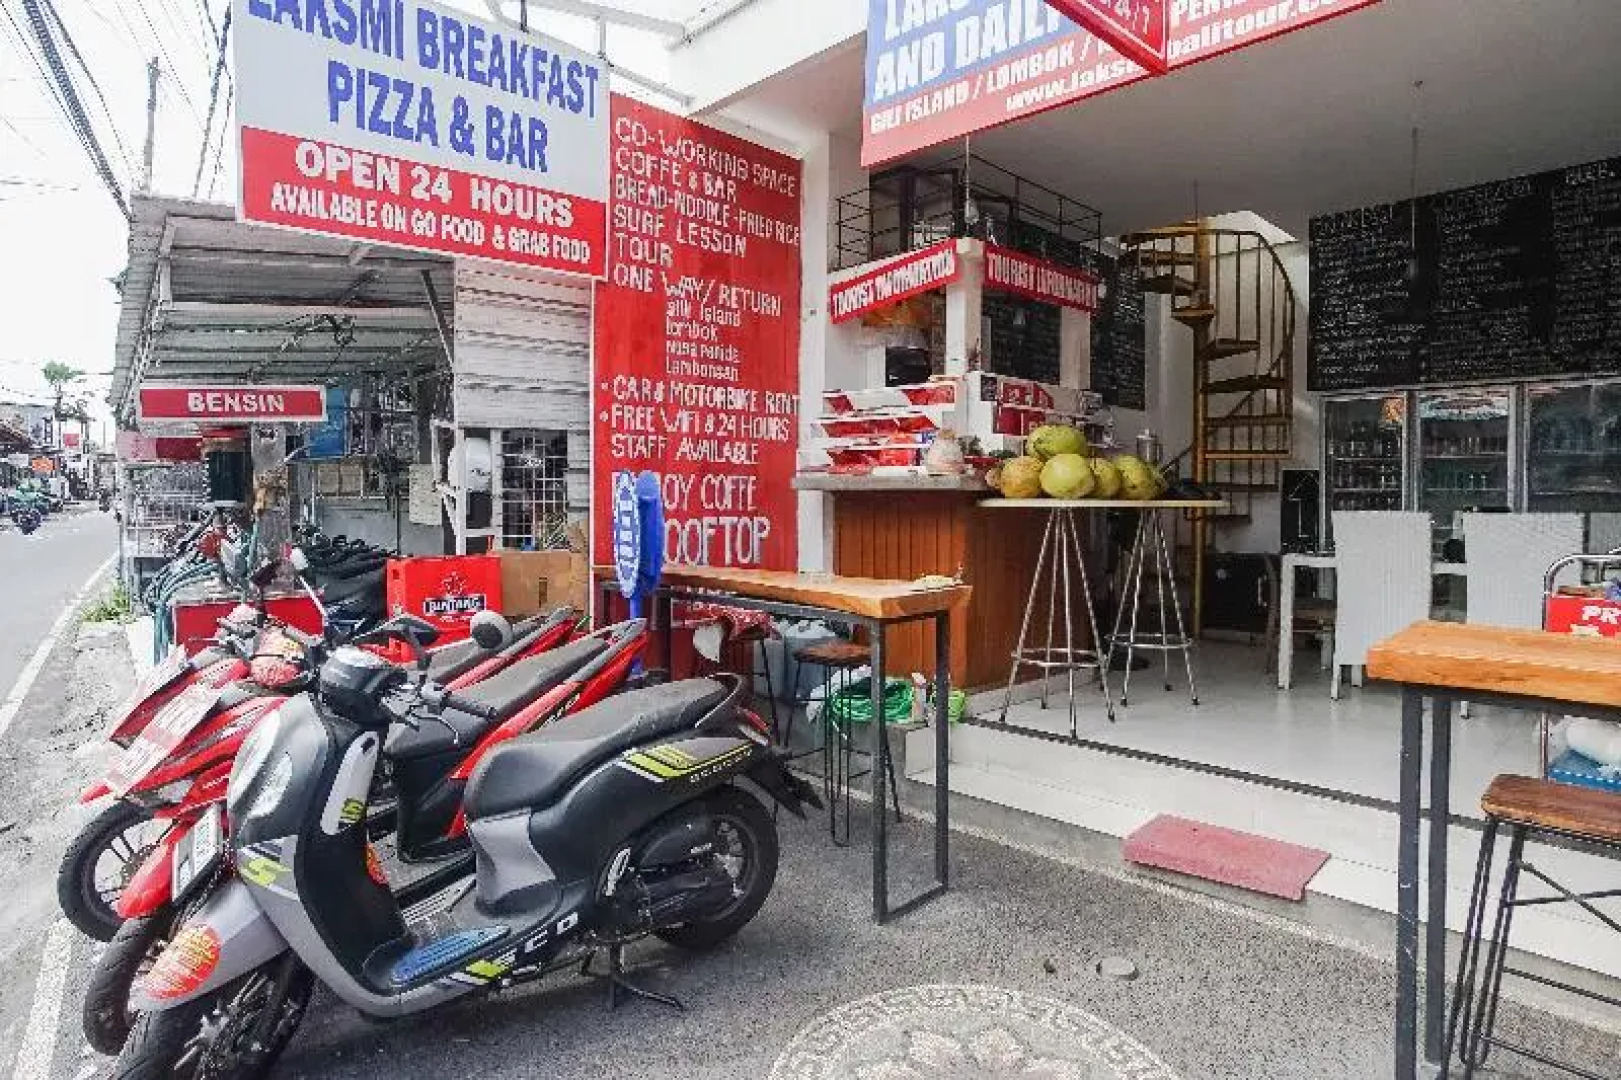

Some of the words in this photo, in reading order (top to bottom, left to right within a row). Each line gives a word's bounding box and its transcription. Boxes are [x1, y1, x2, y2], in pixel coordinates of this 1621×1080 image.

[416, 8, 599, 118] BREAKFAST
[874, 31, 945, 103] AND
[905, 79, 970, 122] ISLAND
[986, 39, 1075, 94] LOMBOK
[327, 60, 438, 147] PIZZA
[450, 95, 475, 157] &
[485, 104, 548, 173] BAR
[295, 140, 401, 195] OPEN
[410, 165, 453, 204] 24
[470, 177, 574, 229] HOURS
[615, 147, 682, 188] COFFE
[703, 171, 737, 202] BAR
[753, 163, 796, 198] SPACE
[270, 182, 378, 229] AVAILABLE
[380, 203, 407, 235] ON
[411, 209, 437, 239] GO
[440, 215, 485, 246] FOOD
[491, 225, 506, 250] &
[508, 229, 551, 258] GRAB
[552, 236, 592, 265] FOOD
[614, 203, 666, 239] SURF
[676, 218, 747, 259] LESSON
[615, 231, 674, 268] TOUR
[613, 263, 654, 293] ONE
[718, 283, 781, 318] RETURN
[187, 392, 285, 413] BENSIN
[611, 403, 656, 432] FREE
[718, 413, 737, 439] 24
[740, 416, 791, 442] HOURS
[765, 390, 800, 415] RENT
[611, 432, 668, 459] STAFF
[674, 437, 760, 465] AVAILABLE
[701, 474, 757, 511] COFFE
[664, 515, 771, 566] OOFTOP
